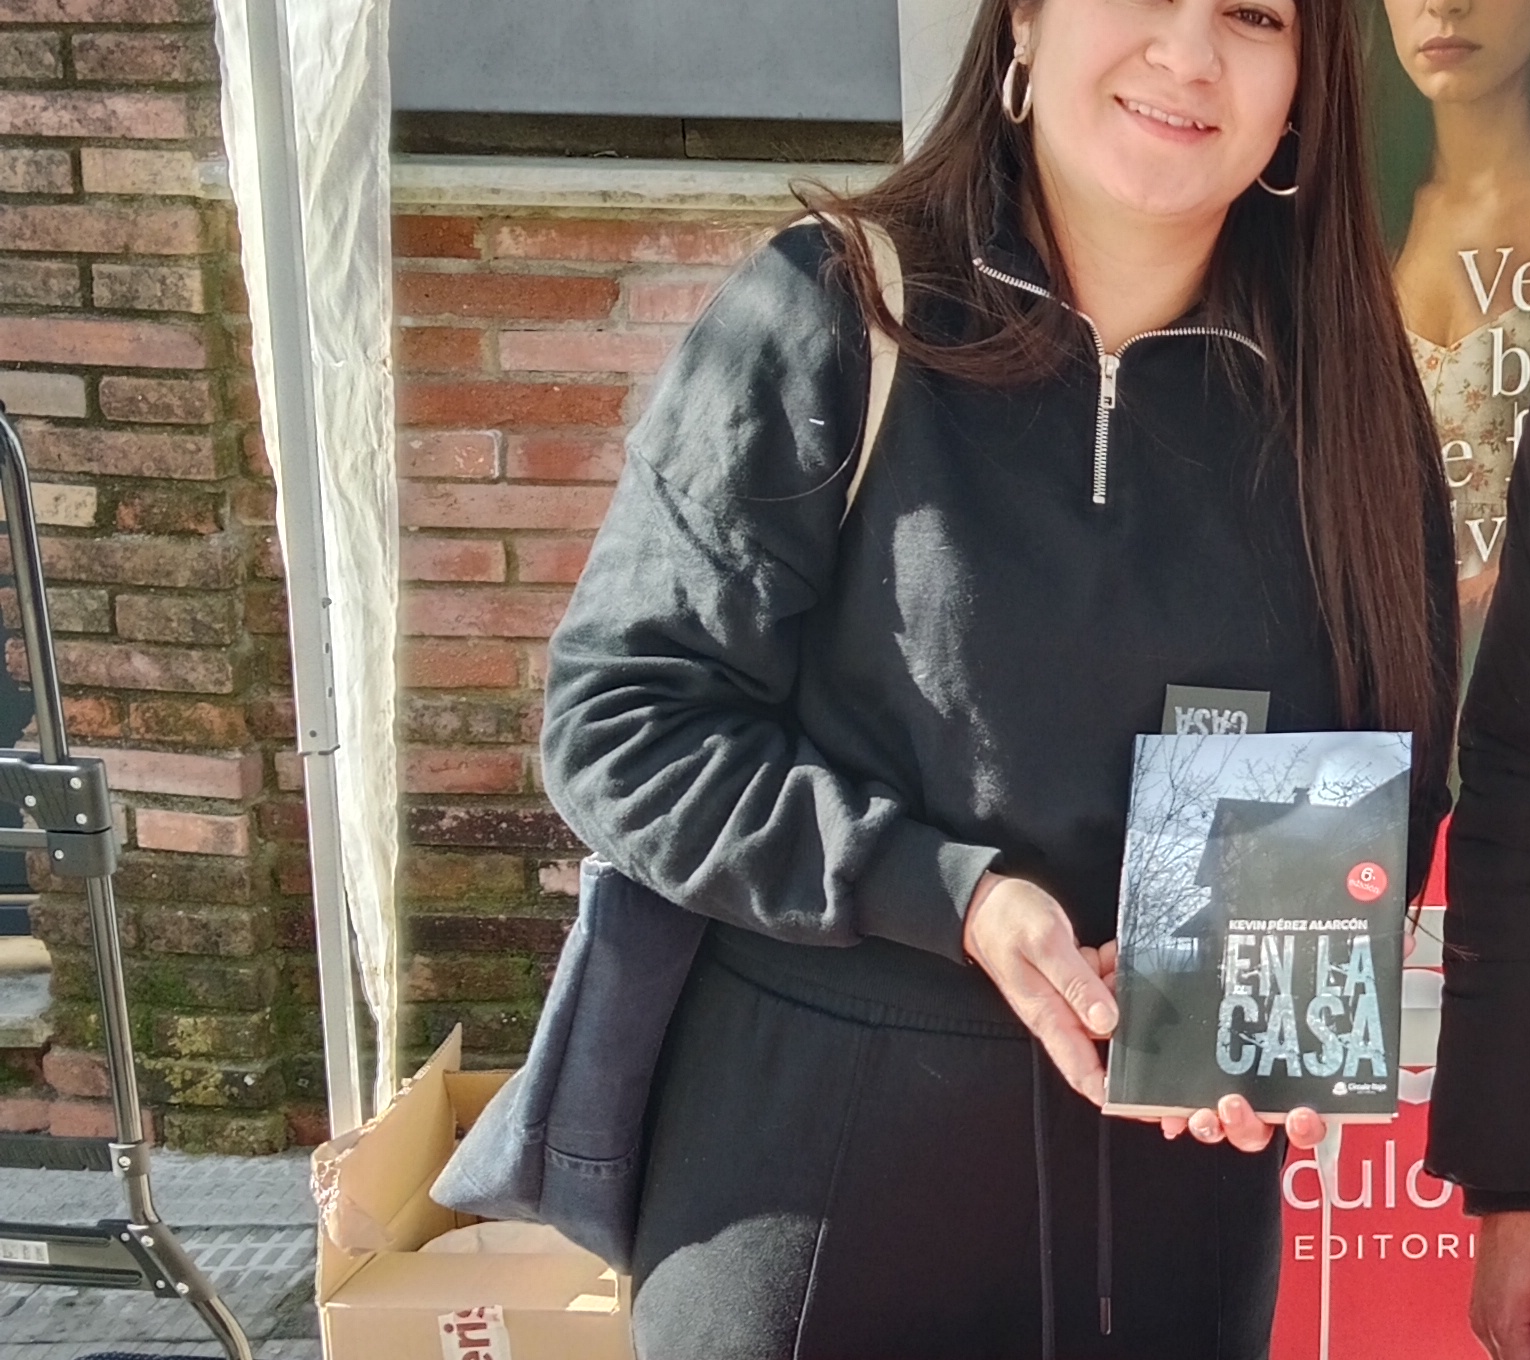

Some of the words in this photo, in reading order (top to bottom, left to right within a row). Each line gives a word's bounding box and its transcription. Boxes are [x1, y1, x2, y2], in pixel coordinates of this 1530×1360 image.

[1175, 705, 1249, 734] CASA
[1229, 919, 1266, 930] KEVIN
[1268, 918, 1307, 930] PÉREZ
[1309, 918, 1368, 930] ALARCÓN
[1222, 935, 1295, 996] EN
[1316, 935, 1376, 996] LA
[1216, 994, 1388, 1077] CASA
